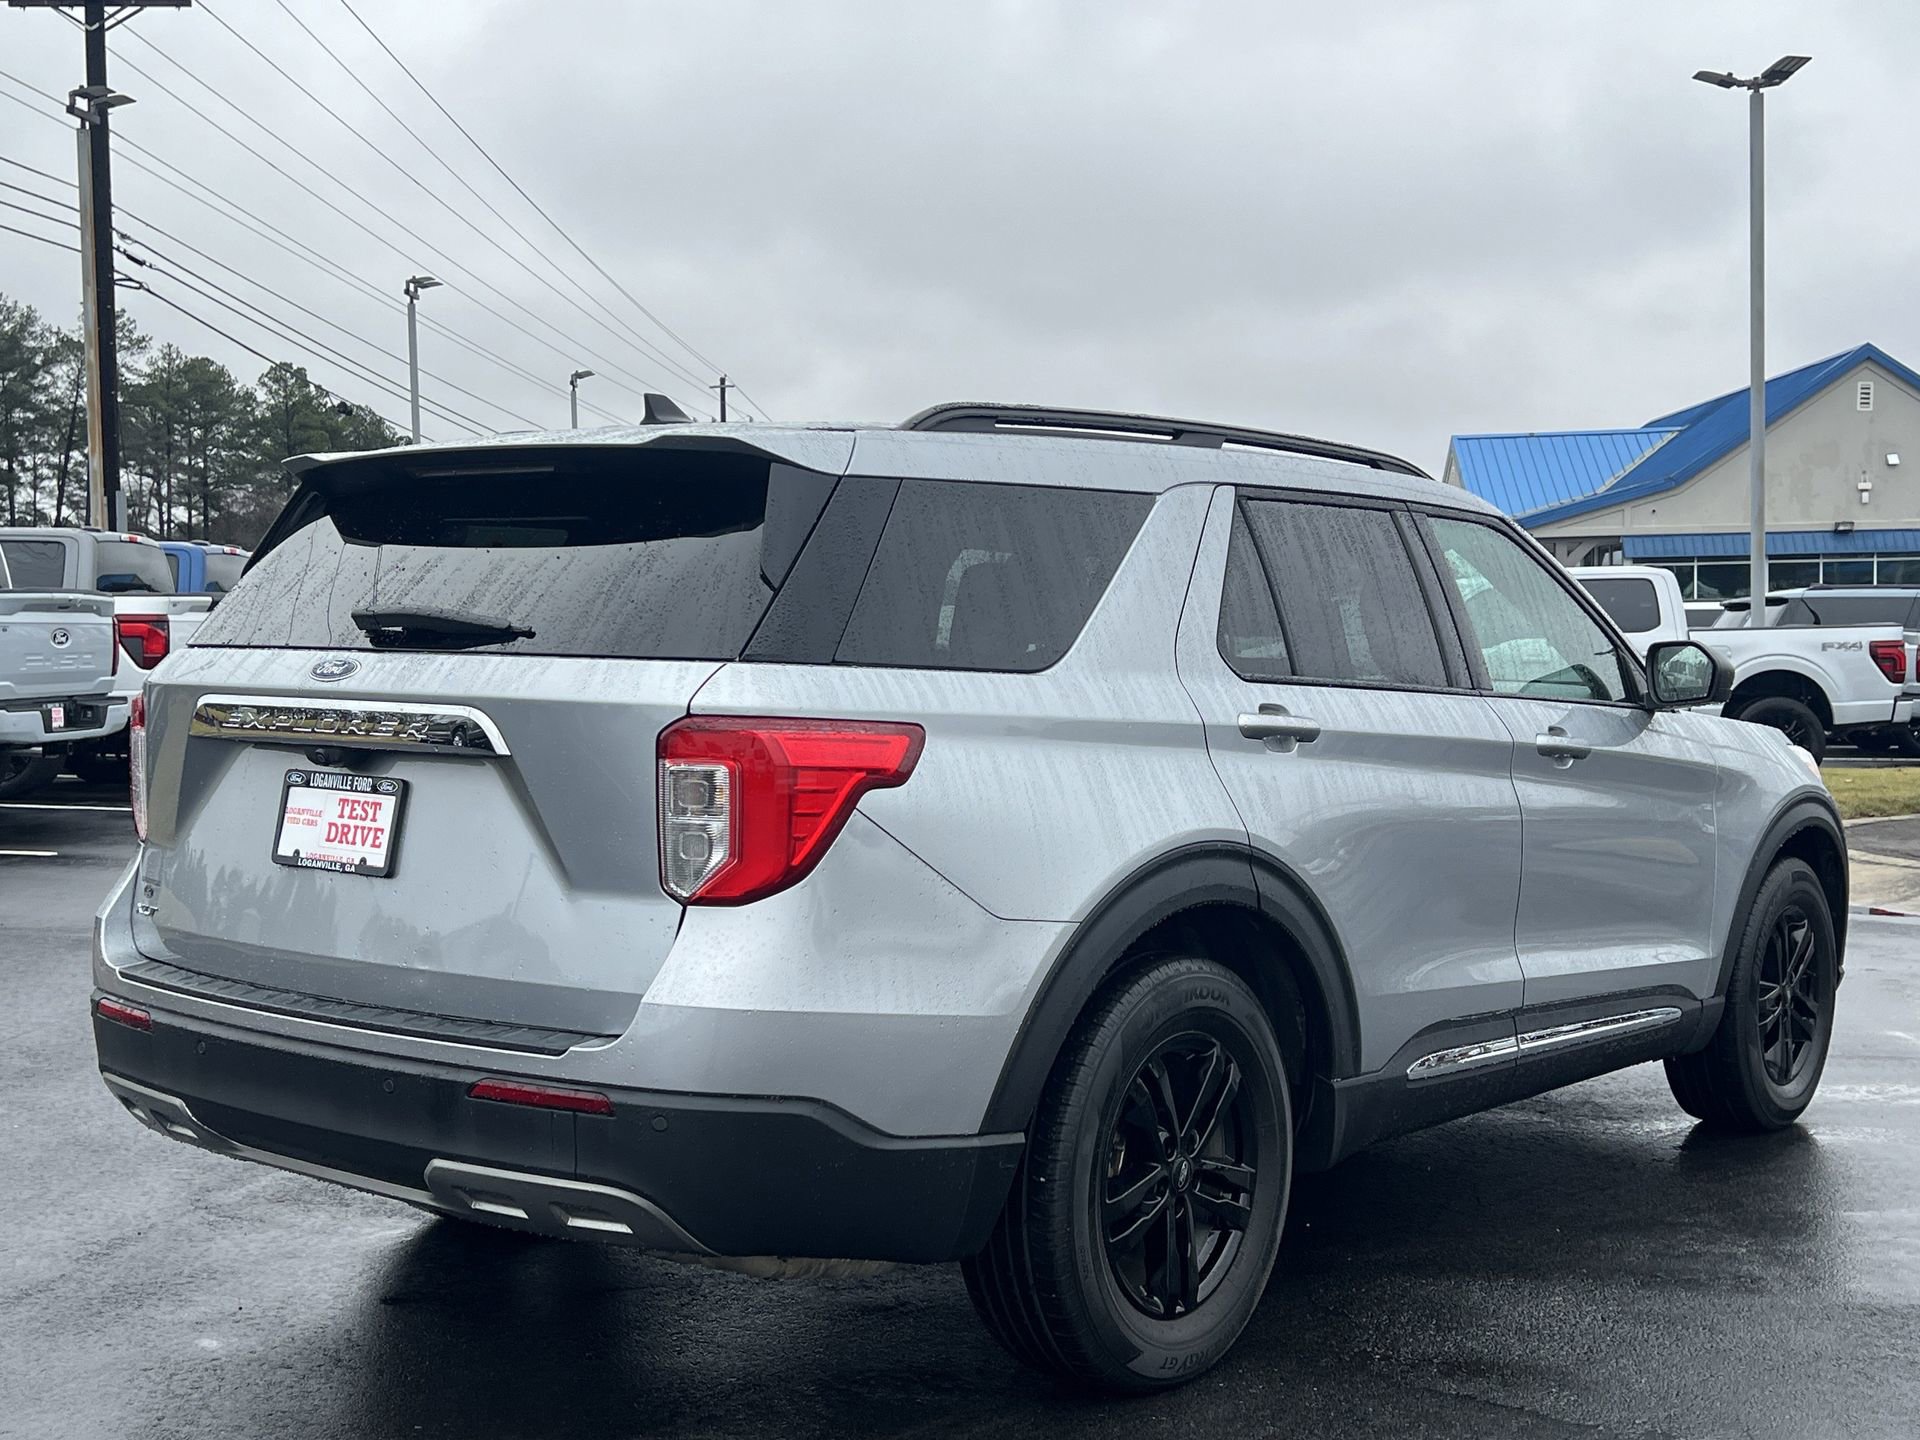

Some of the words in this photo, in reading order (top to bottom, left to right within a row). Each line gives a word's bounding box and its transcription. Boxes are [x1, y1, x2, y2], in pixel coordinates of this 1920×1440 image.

[1821, 641, 1862, 651] FX4
[222, 710, 429, 738] EXPLORER
[310, 773, 353, 790] LOGANVILLE
[353, 775, 373, 791] FORD
[337, 798, 382, 822] TEST
[325, 822, 385, 848] DRIVE
[345, 864, 356, 873] GA
